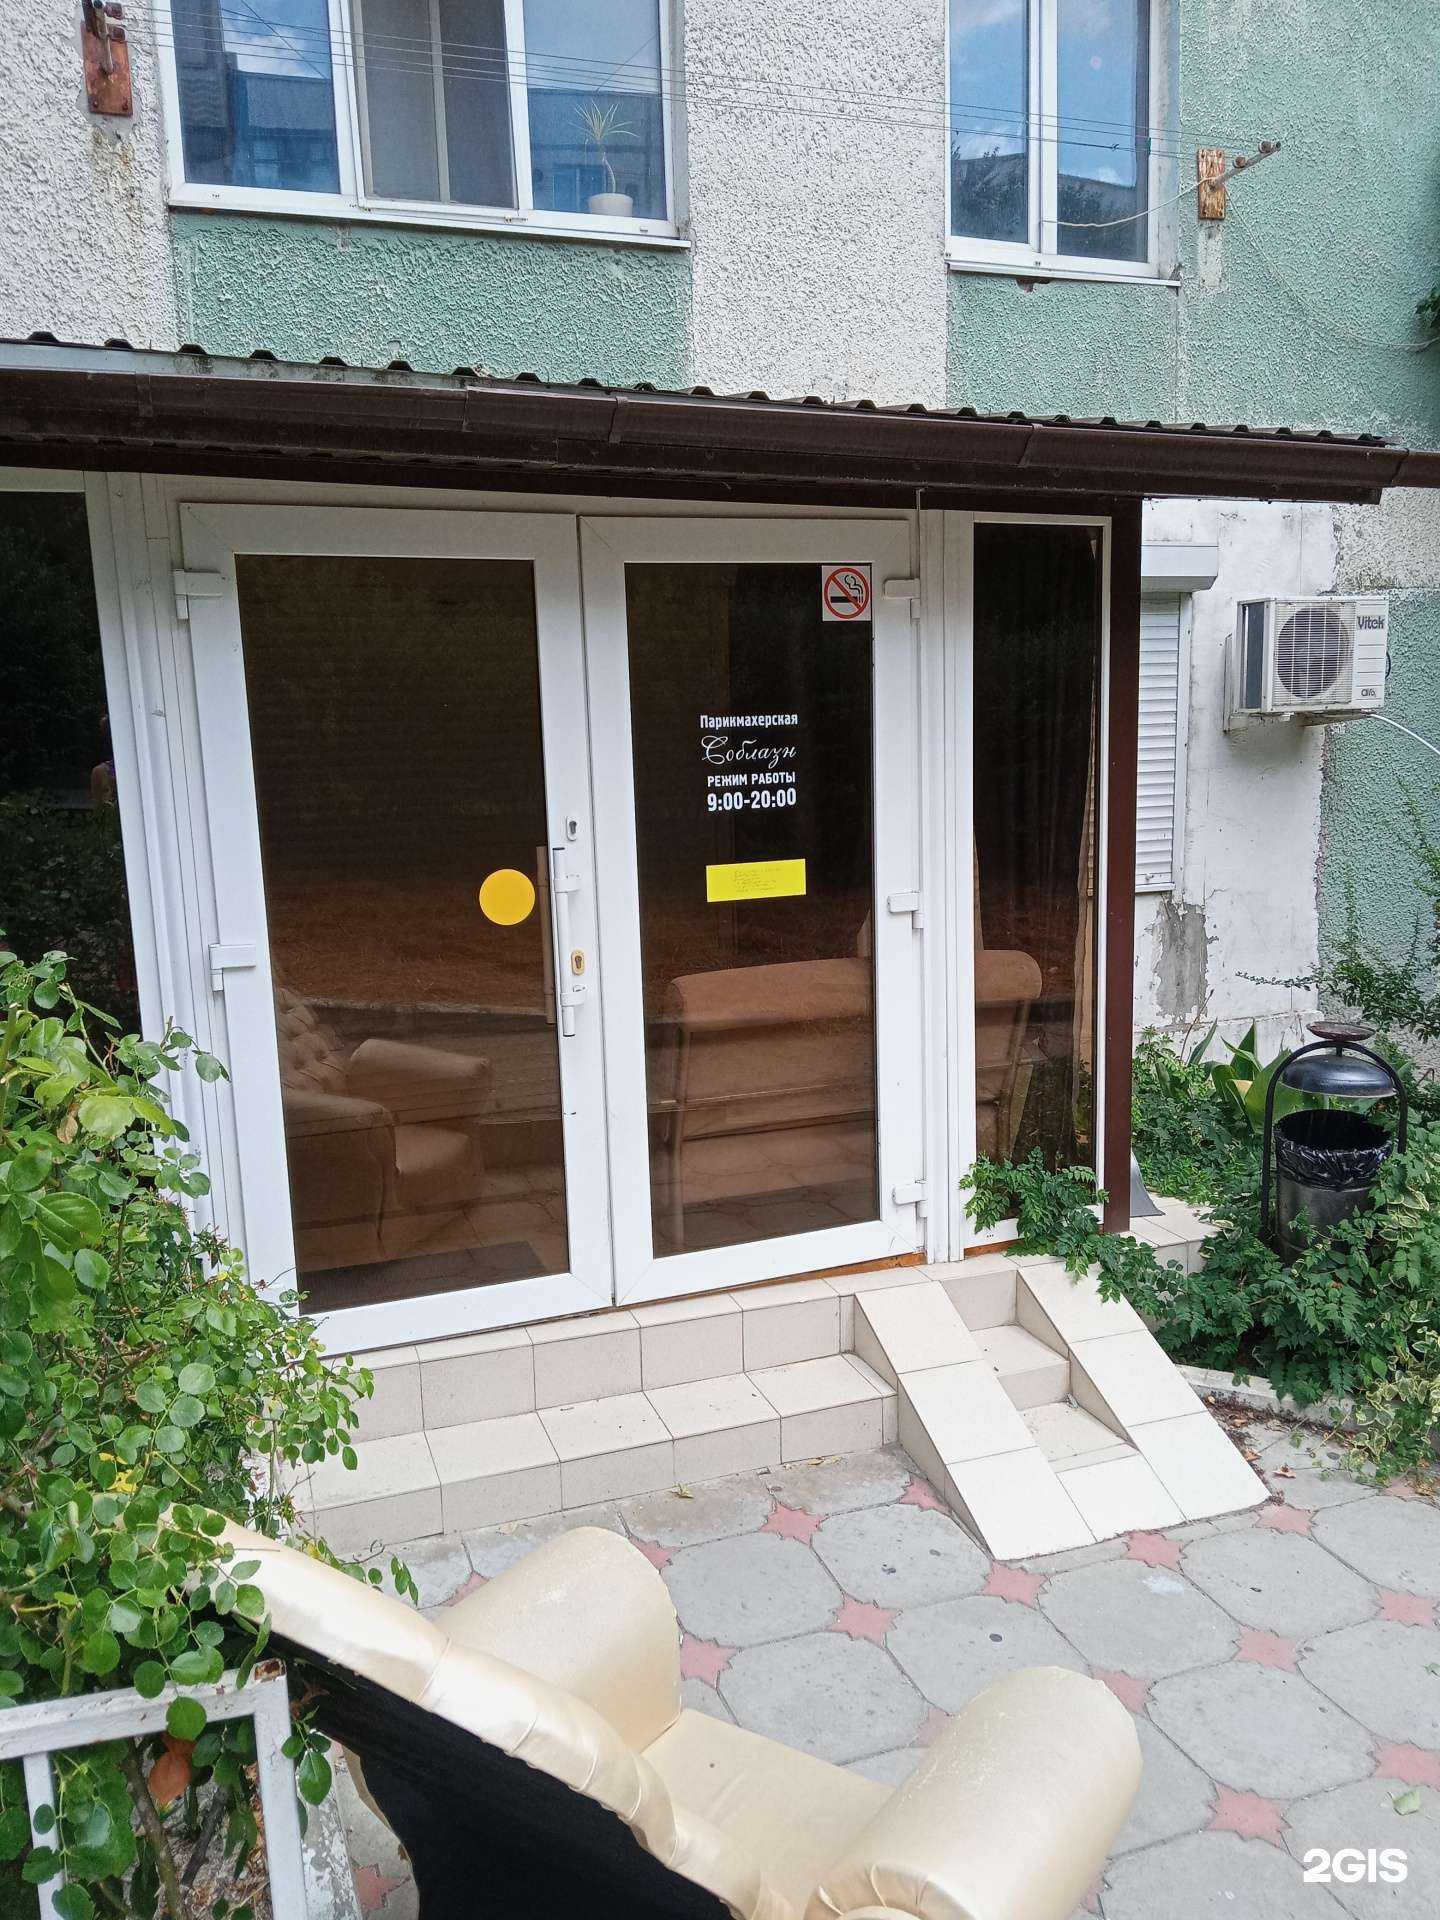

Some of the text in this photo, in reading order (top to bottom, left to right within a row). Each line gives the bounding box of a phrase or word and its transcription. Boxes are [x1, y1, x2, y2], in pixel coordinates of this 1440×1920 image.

[1357, 615, 1385, 630] Vitek
[700, 714, 798, 730] Парикмахерская
[701, 735, 797, 769] Соблазн
[707, 771, 796, 787] РЕЖИМ РАБОТЫ
[707, 788, 797, 812] 9:00-20:00
